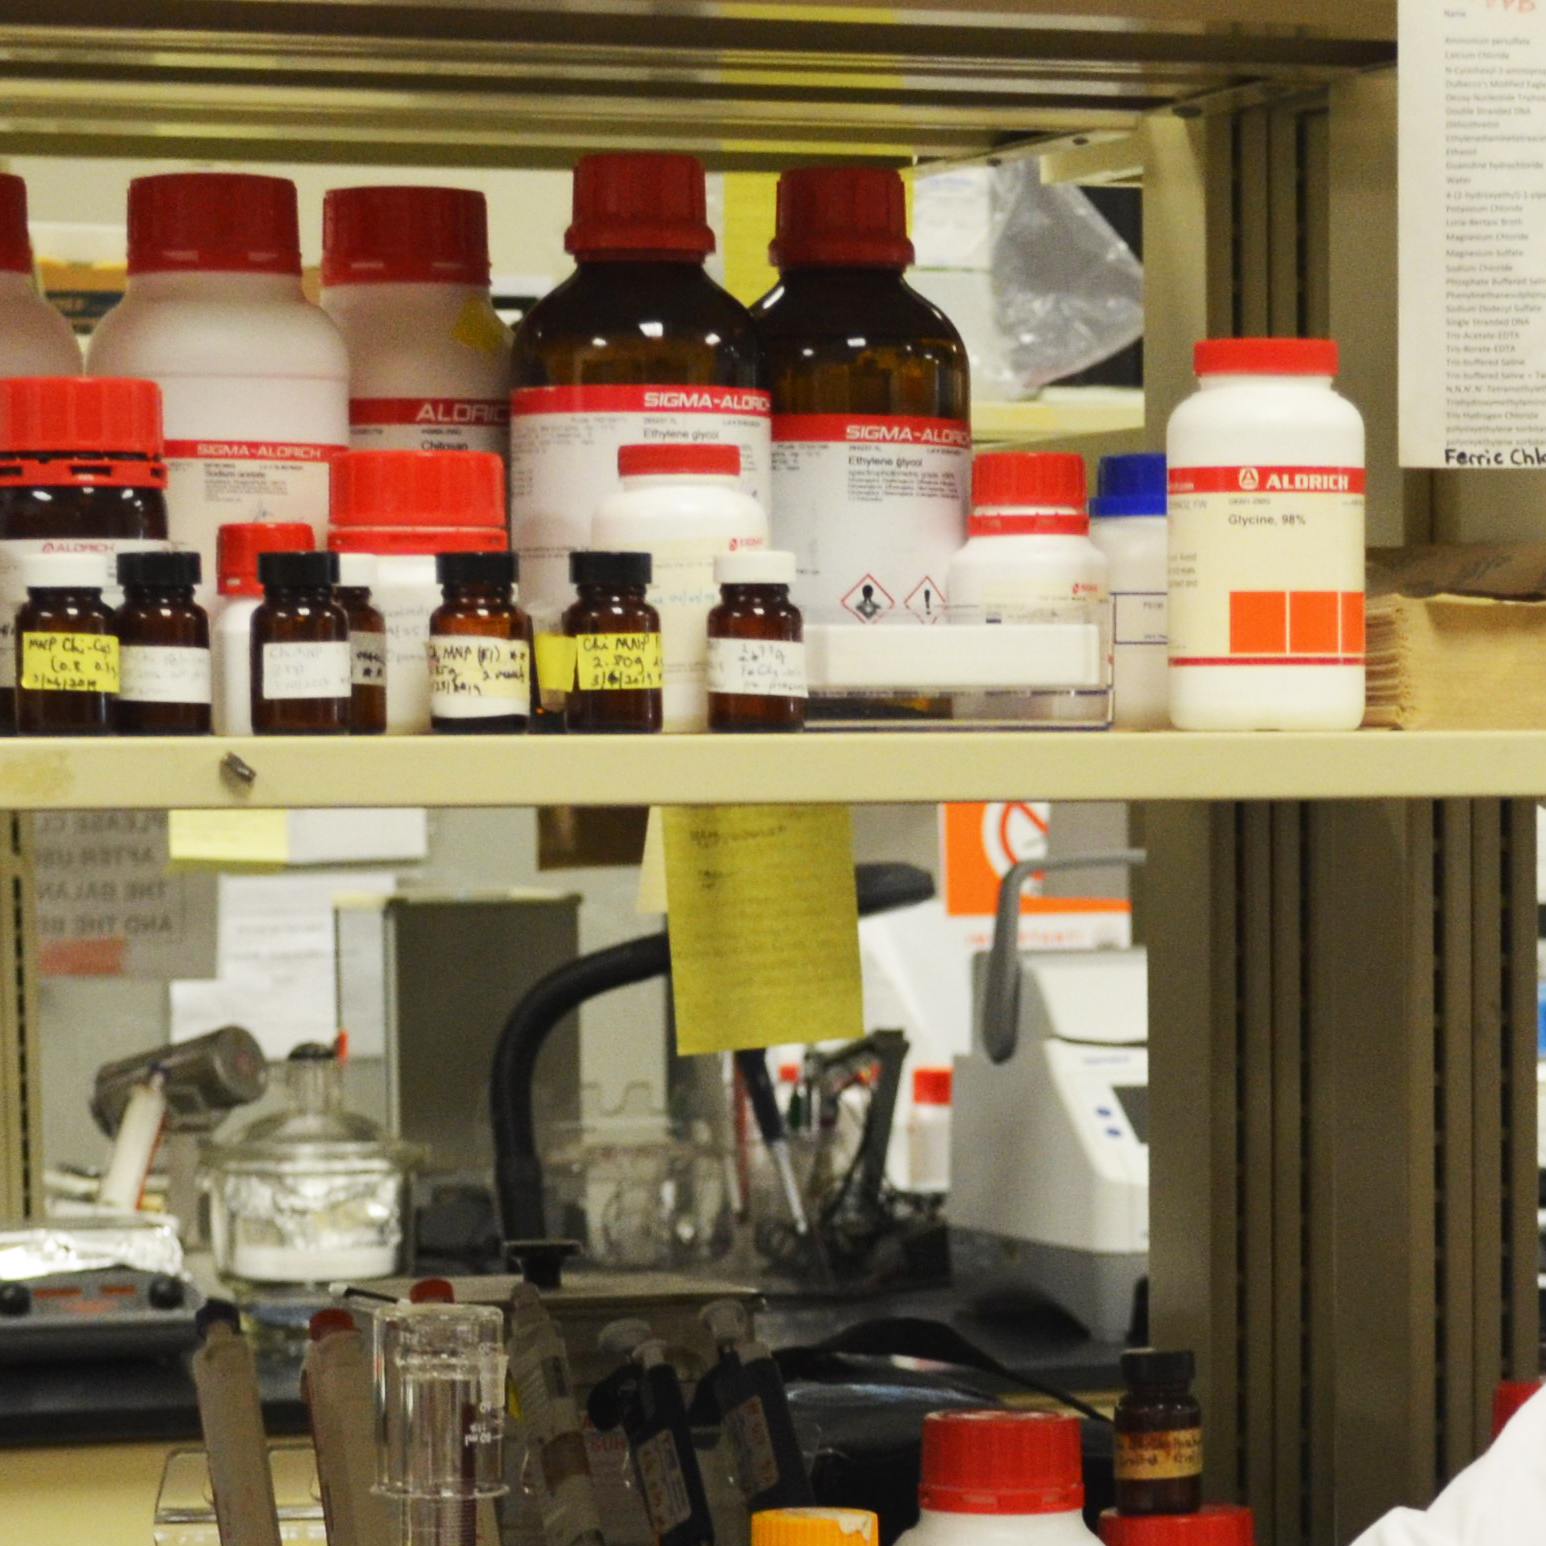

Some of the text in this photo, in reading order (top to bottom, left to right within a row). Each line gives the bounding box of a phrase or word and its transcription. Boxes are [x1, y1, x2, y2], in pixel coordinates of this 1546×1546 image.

[643, 428, 720, 442] Ethylene glycol
[197, 443, 322, 459] SIGMA-ALDRICH
[421, 440, 468, 451] Chitosan
[848, 455, 924, 470] Ethylene glycol
[1444, 448, 1504, 466] Ferric
[205, 470, 267, 480] Sodium acetate
[1266, 473, 1349, 491] ALDRICH
[1228, 513, 1306, 527] Glycine, 98%
[56, 544, 115, 553] ALDRICH
[583, 636, 608, 652] Chi
